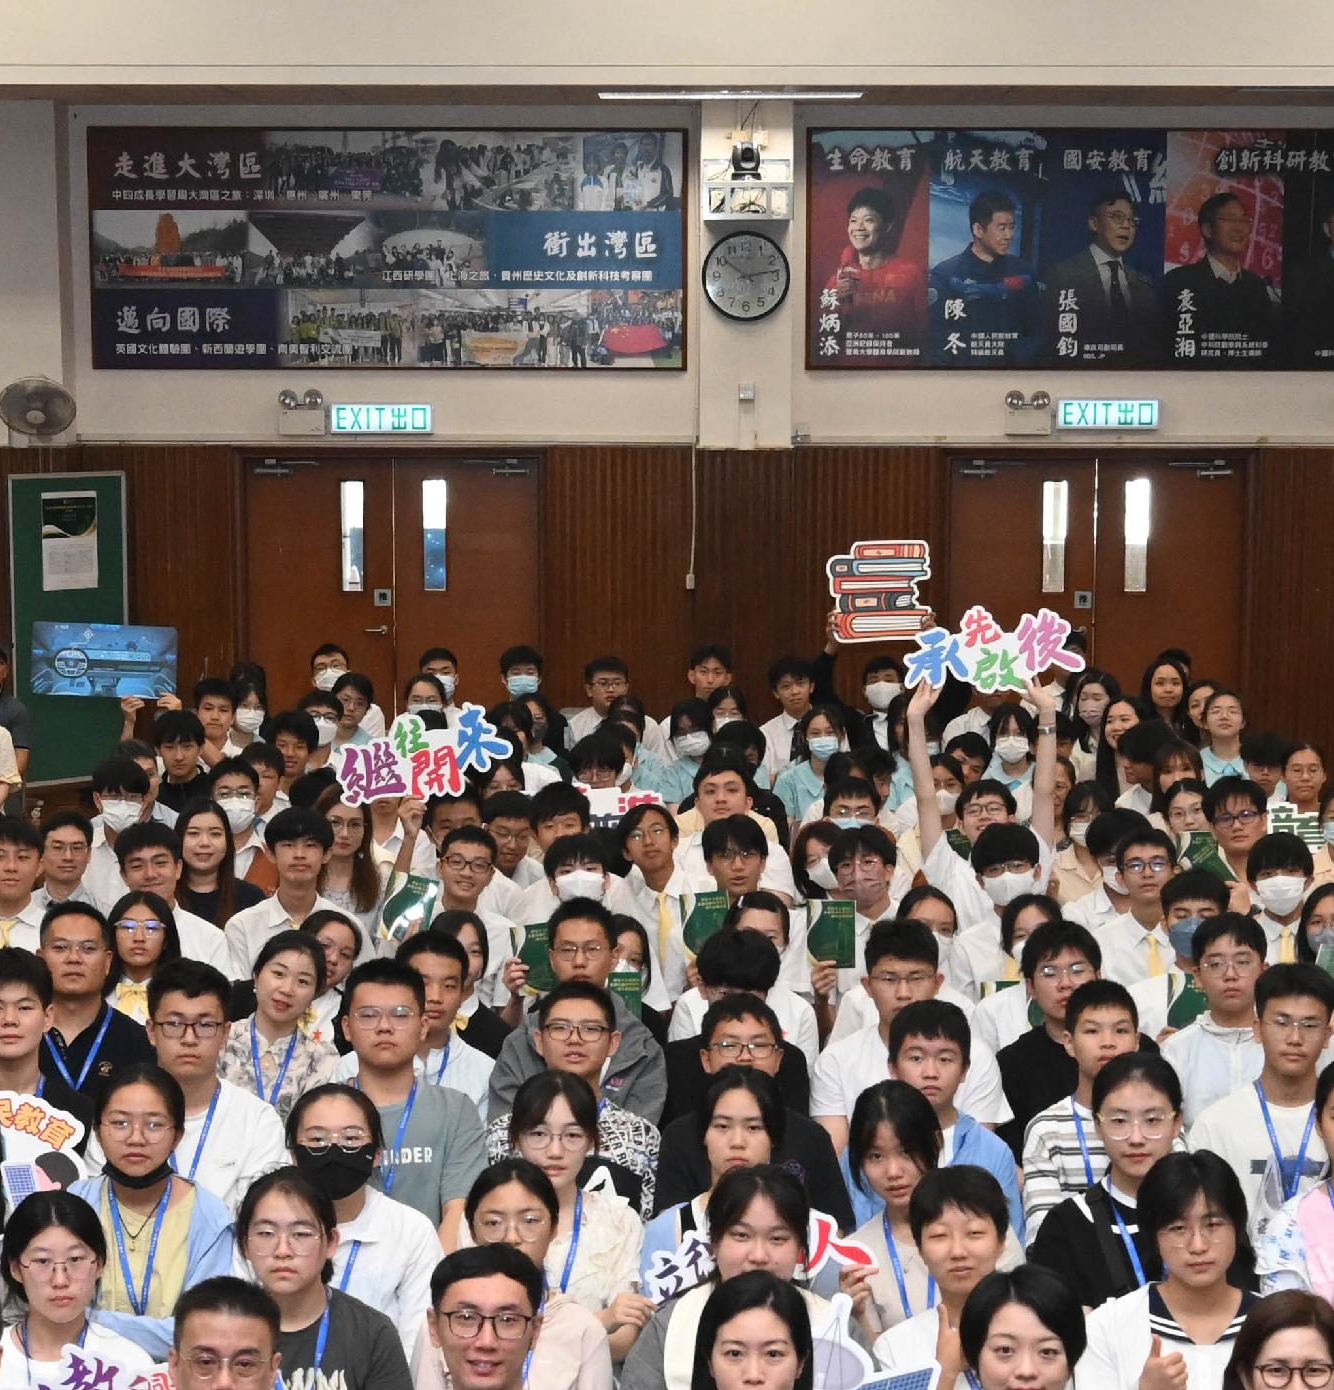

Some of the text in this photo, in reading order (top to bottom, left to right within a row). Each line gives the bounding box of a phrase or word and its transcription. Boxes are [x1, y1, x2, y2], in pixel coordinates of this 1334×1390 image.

[113, 151, 262, 179] 走進大灣區
[826, 147, 916, 172] 生命教育
[943, 148, 1032, 173] 航天教育
[1062, 148, 1153, 172] 國安教育
[543, 230, 658, 259] 衝出灣區
[757, 245, 764, 256] 1
[716, 256, 727, 267] 10
[767, 255, 777, 266] 2
[712, 271, 722, 280] 9
[772, 271, 780, 282] 3
[717, 287, 725, 298] 8
[728, 297, 736, 308] 7
[756, 297, 766, 308] 5
[767, 287, 776, 296] 4
[741, 301, 751, 313] 6
[116, 305, 232, 333] 邁向國際
[818, 288, 842, 357] 蘇炳添
[943, 298, 967, 355] 陳冬
[1174, 288, 1198, 358] 袁亞湘
[335, 407, 427, 430] EXIT 出口
[1063, 402, 1154, 425] EXIT 出口
[908, 609, 1082, 690] 承先啟後
[341, 707, 509, 804] 繼往開來
